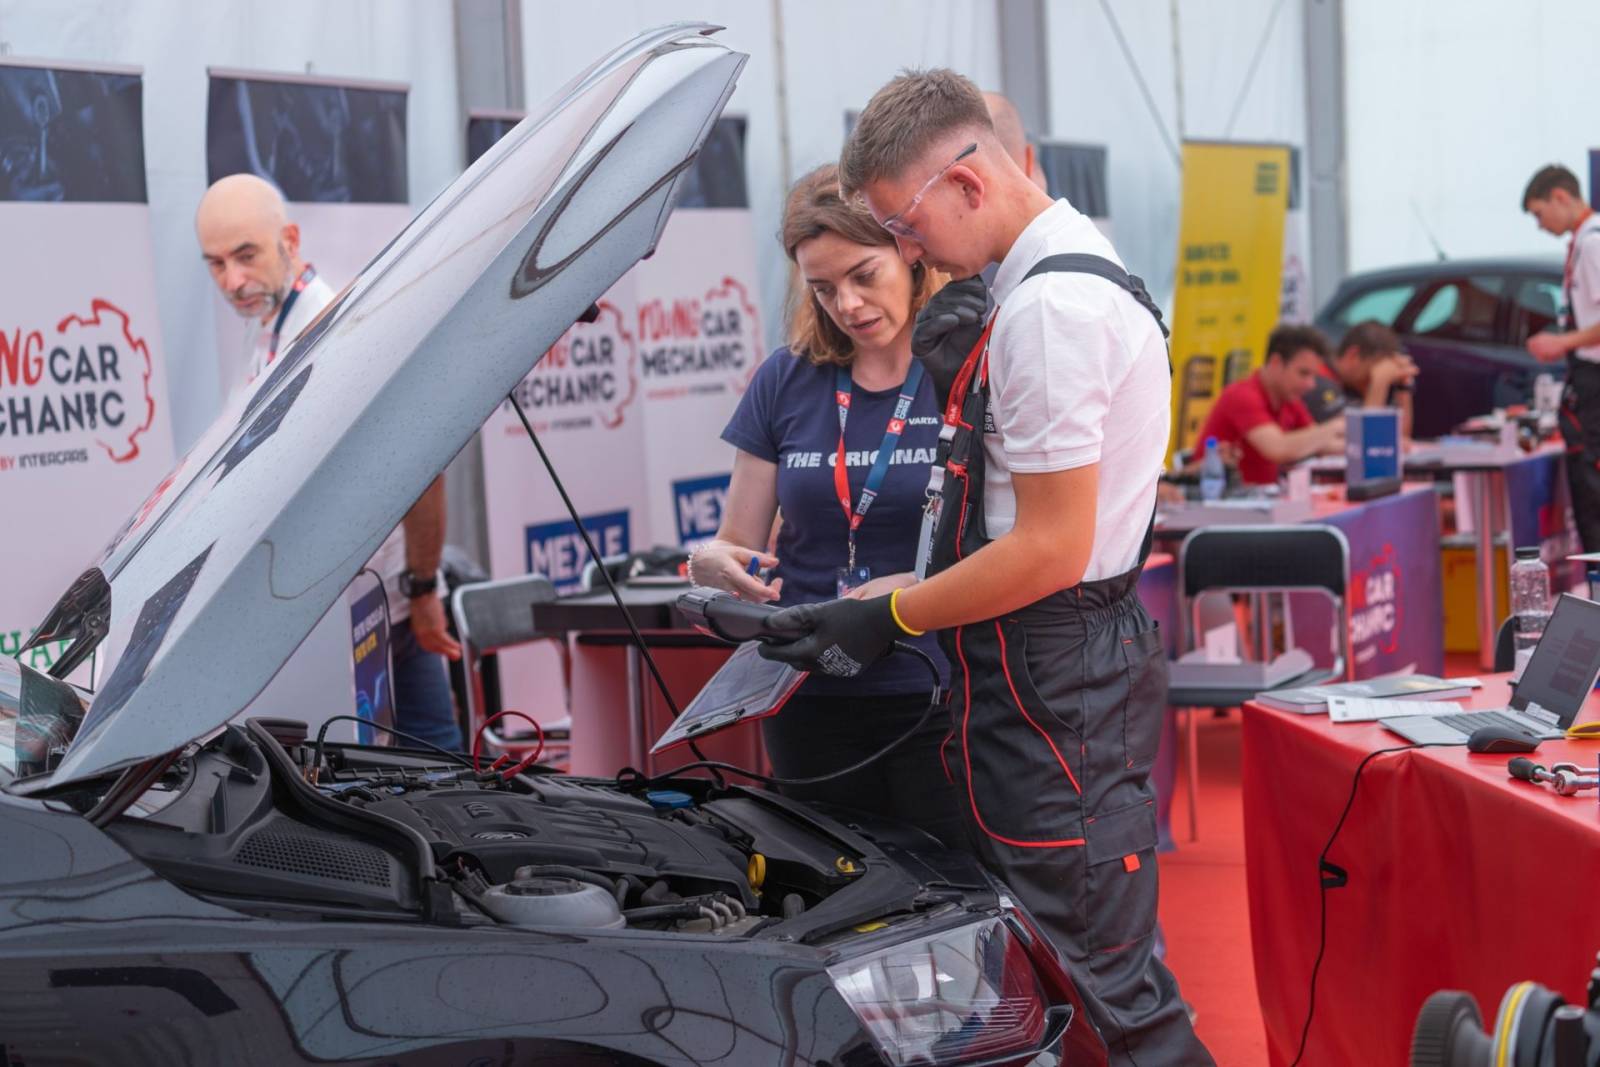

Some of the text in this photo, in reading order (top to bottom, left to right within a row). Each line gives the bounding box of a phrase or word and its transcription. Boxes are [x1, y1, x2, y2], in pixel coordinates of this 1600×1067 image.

[703, 309, 742, 337] CAR
[49, 345, 121, 384] CAR
[570, 336, 615, 367] CAR
[641, 341, 745, 377] MECHANIC
[908, 417, 938, 425] VARTA
[19, 449, 88, 469] INTERCARS
[786, 452, 822, 468] THE
